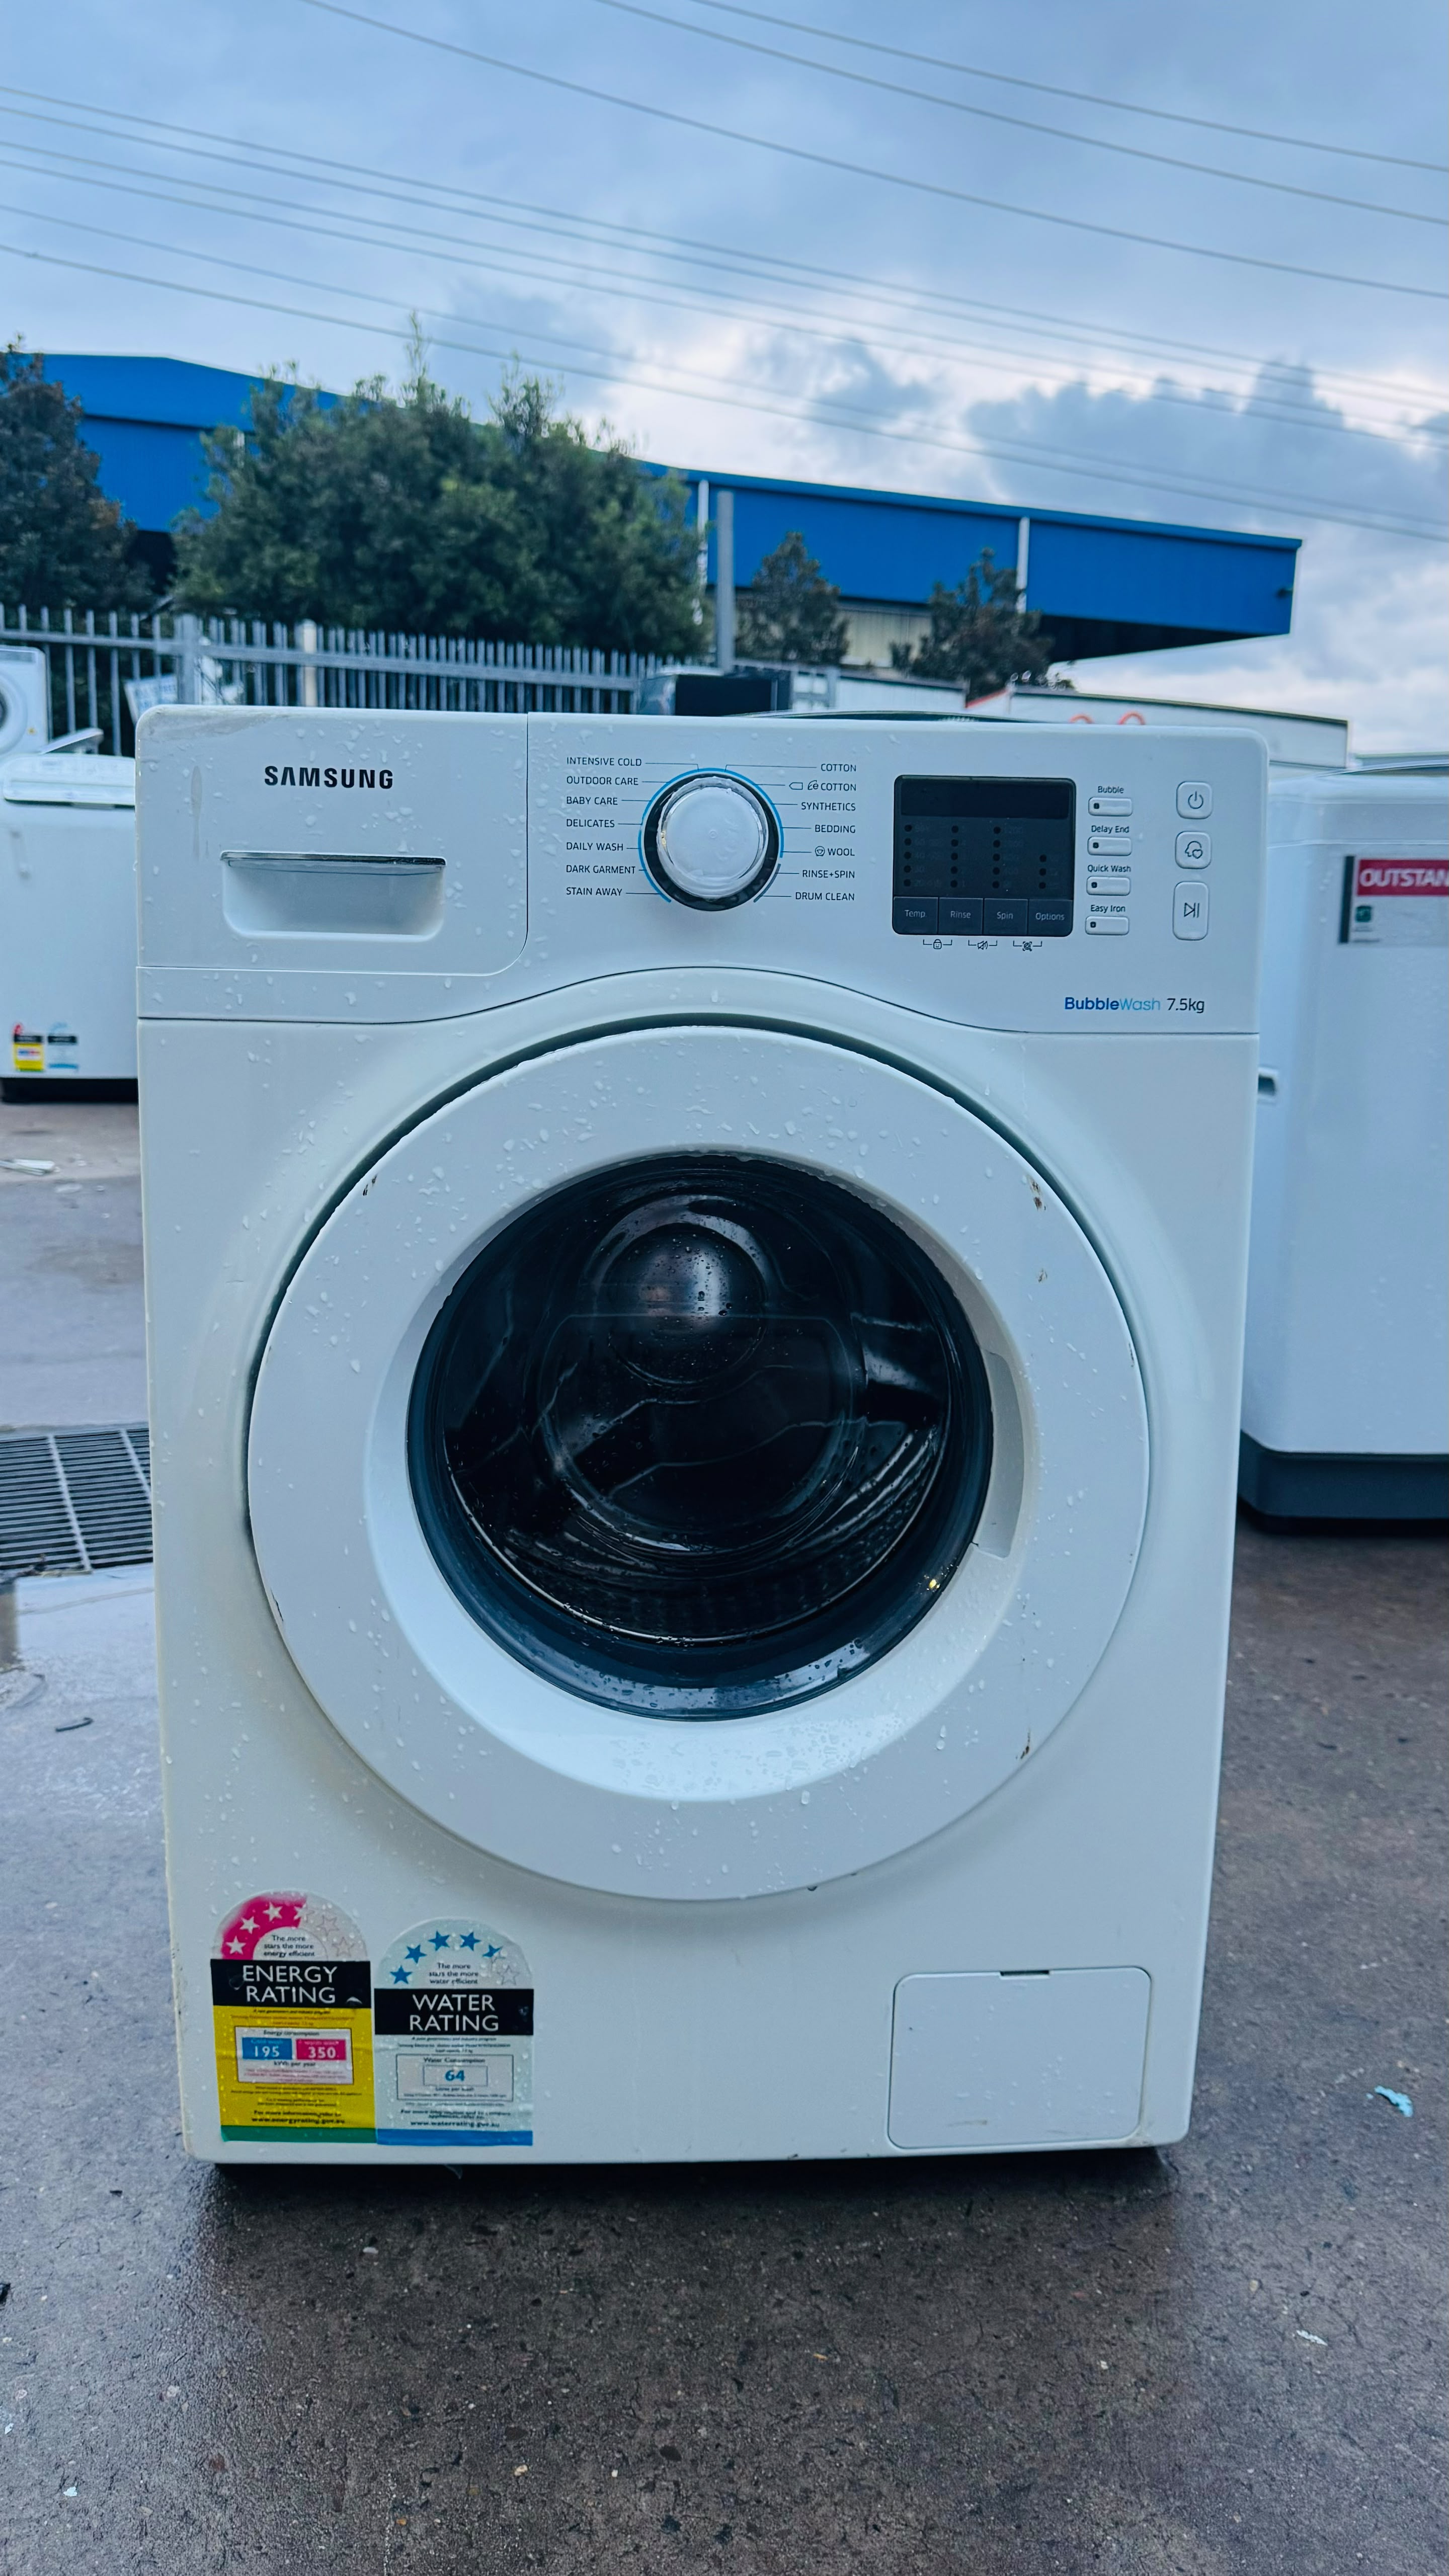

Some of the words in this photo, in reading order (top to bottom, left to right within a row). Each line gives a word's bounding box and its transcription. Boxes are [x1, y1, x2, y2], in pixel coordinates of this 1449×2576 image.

[567, 757, 615, 766] INTENSIVE
[618, 758, 642, 766] COLD
[821, 763, 856, 772] COTTON
[264, 765, 393, 789] SAMSUNG
[567, 776, 612, 785] OUTDOOR
[615, 777, 639, 785] CARE
[821, 782, 856, 791] COTTON
[1097, 785, 1124, 794] Bubble
[567, 796, 591, 804] BABY
[594, 797, 618, 806] CARE
[801, 801, 856, 812] SYNTHETICS
[566, 819, 615, 828] DELICATES
[815, 824, 856, 834] BEDDING
[1091, 825, 1113, 834] Delay
[566, 842, 593, 850] DAILY
[596, 842, 623, 851] WASH
[827, 848, 855, 856] WOOL
[566, 864, 590, 873] DARK
[593, 865, 636, 874] GARMENT
[1087, 864, 1109, 873] Quick
[802, 869, 855, 878] RINSE+SPIN
[566, 887, 593, 896] STAIN
[595, 888, 622, 896] AWAY
[795, 892, 822, 900] DRUM
[825, 892, 855, 901] CLEAN
[1090, 904, 1108, 914] Easy
[1110, 905, 1125, 913] Iron
[950, 910, 971, 919] Rinse
[996, 911, 1013, 920] Spin
[1035, 912, 1065, 921] Options
[1065, 997, 1160, 1010] BubbleWash
[1167, 998, 1204, 1014] 7.5kg
[243, 1965, 338, 1983] ENERGY
[246, 1985, 336, 2003] RATING
[412, 1994, 495, 2011] WATER
[410, 2015, 499, 2032] RATING
[255, 2045, 280, 2058] 195
[308, 2046, 336, 2059] 350
[445, 2069, 465, 2081] 64
